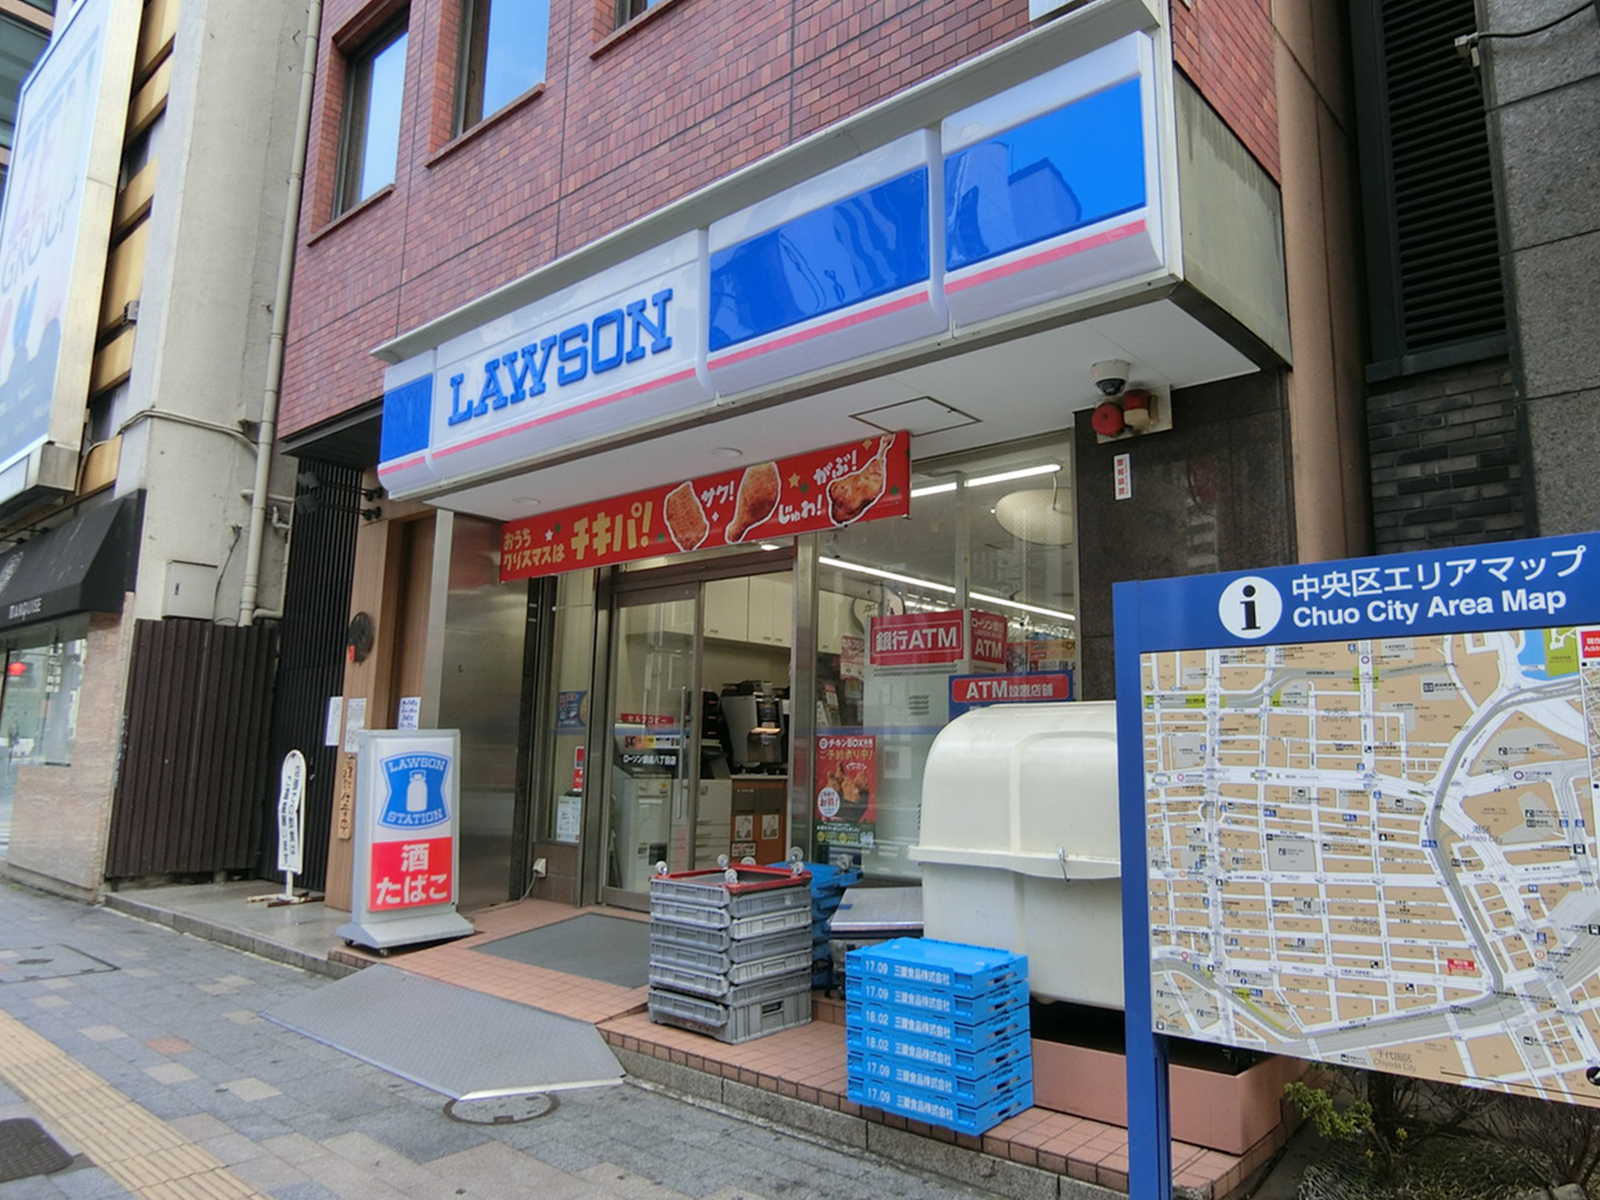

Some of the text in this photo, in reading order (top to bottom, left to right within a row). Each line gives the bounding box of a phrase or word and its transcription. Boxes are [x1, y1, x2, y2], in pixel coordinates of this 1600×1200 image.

[448, 288, 673, 426] LAWSON
[701, 480, 734, 508] サク!
[778, 494, 822, 525] じゅわ!
[503, 528, 531, 551] おうち
[571, 501, 653, 560] チキパ!
[503, 543, 565, 571] クリスマスは
[1292, 545, 1586, 601] 中央区エリアマップ
[1293, 589, 1566, 627] Chuo City Area Map
[876, 626, 957, 652] 銀行ATM
[974, 639, 1002, 659] ATM
[388, 757, 446, 773] LAWSON
[387, 808, 443, 825] STATION
[400, 843, 430, 872] 酒
[376, 873, 447, 905] たばこ
[865, 960, 888, 974] 17.09
[865, 985, 889, 1000] 17.09
[866, 1010, 889, 1026] 18.02
[866, 1036, 889, 1051] 18.02
[867, 1061, 890, 1077] 17.09
[868, 1087, 891, 1103] 17.09
